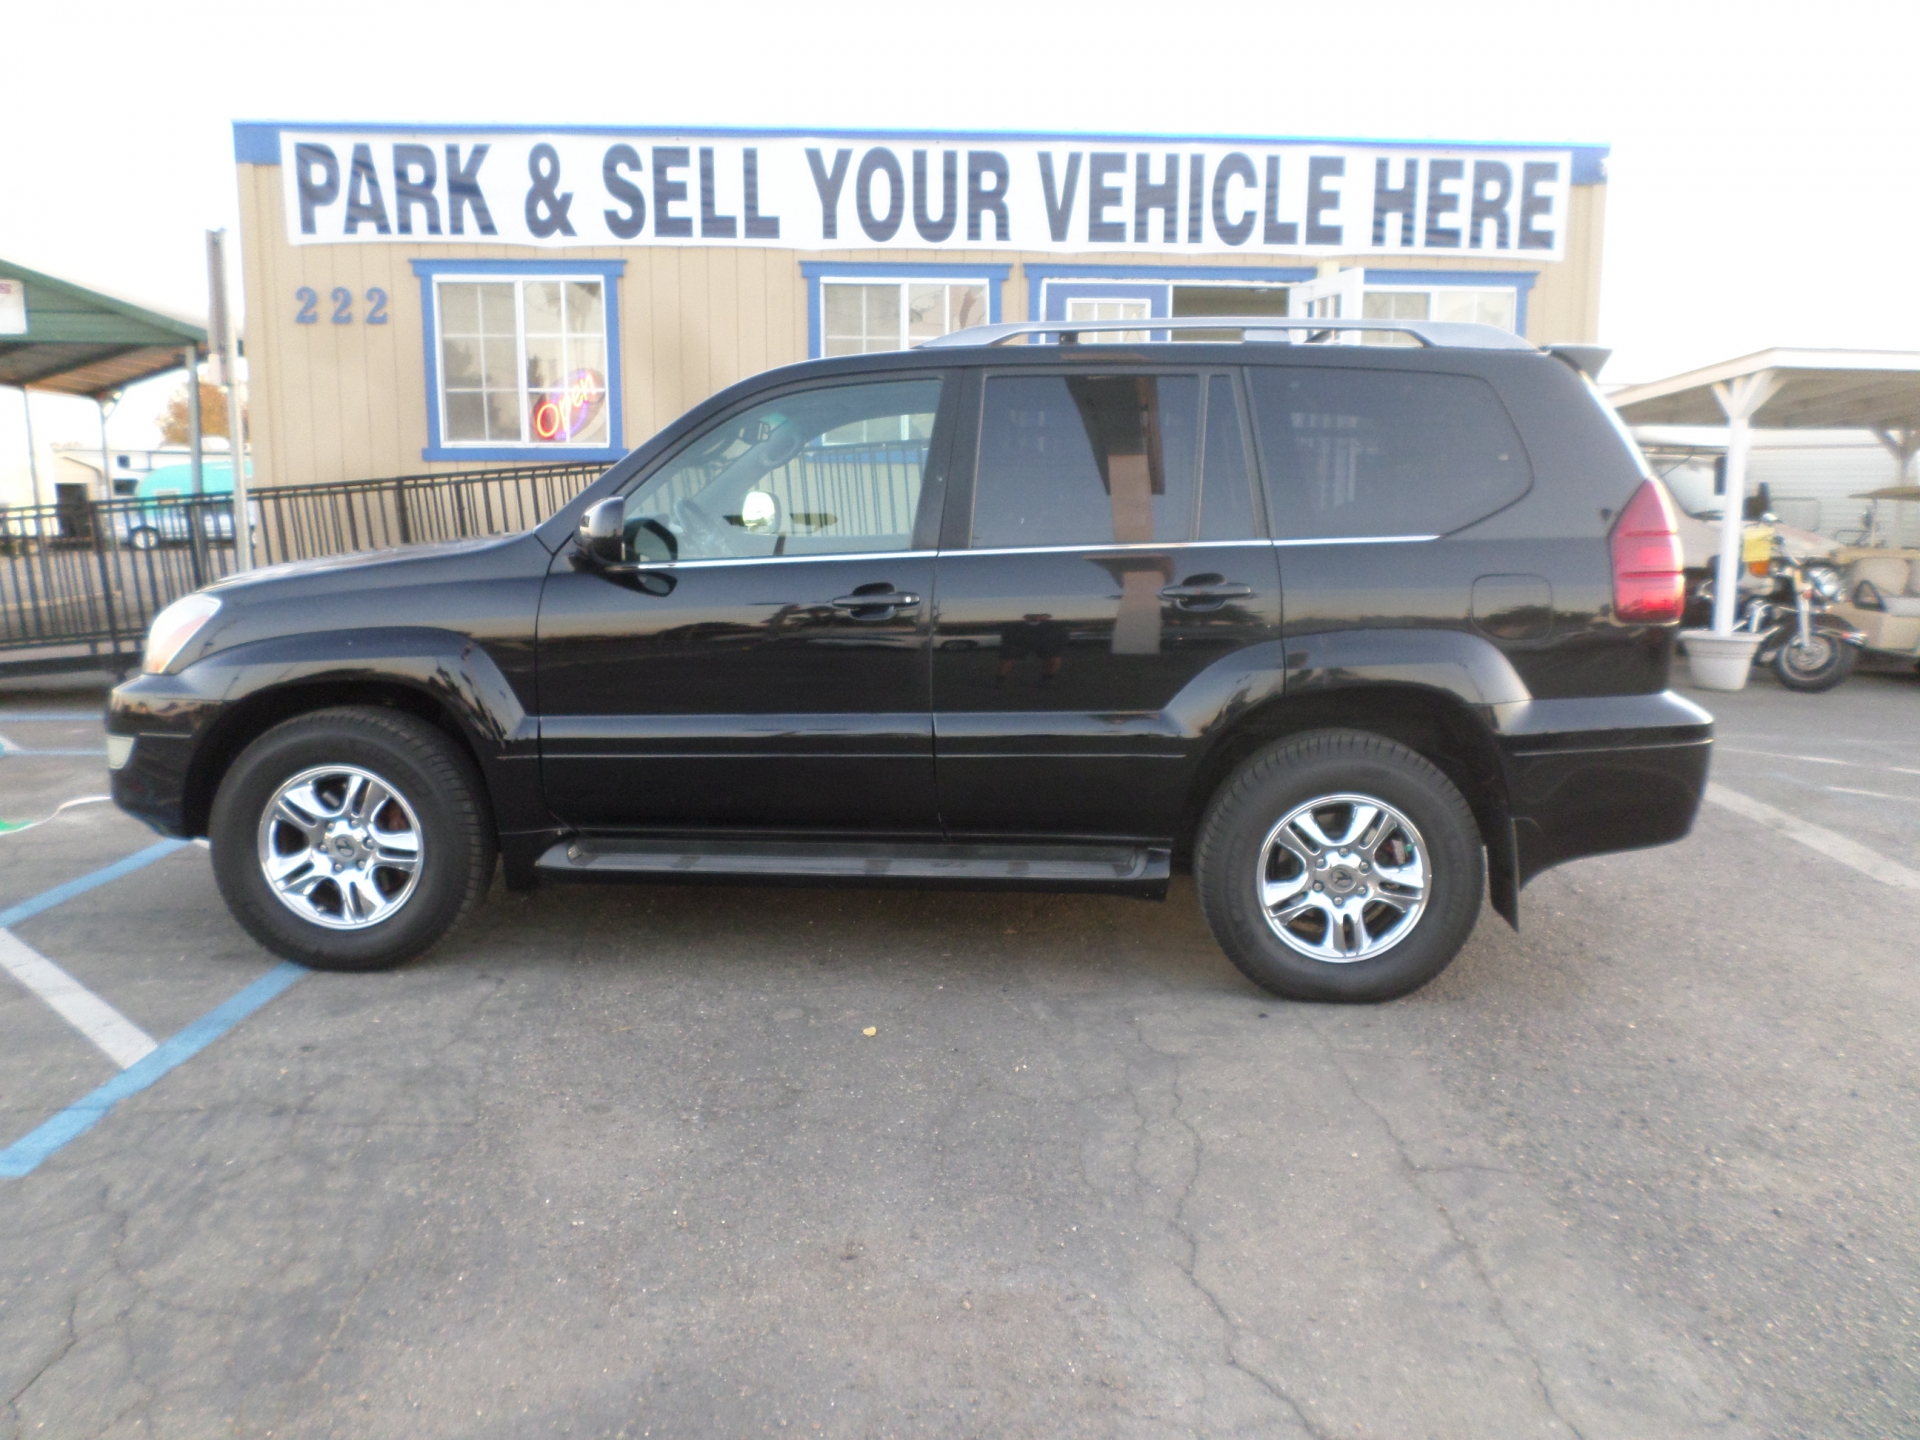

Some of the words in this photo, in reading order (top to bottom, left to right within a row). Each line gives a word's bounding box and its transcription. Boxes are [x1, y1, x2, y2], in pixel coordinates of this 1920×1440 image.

[294, 142, 499, 236] PARK
[524, 142, 578, 239] &
[602, 144, 780, 240] SELL
[804, 147, 1011, 243] YOUR
[1037, 150, 1346, 247] VEHICLE
[1371, 156, 1561, 250] HERE
[295, 286, 388, 324] 222
[536, 372, 597, 438] Open
